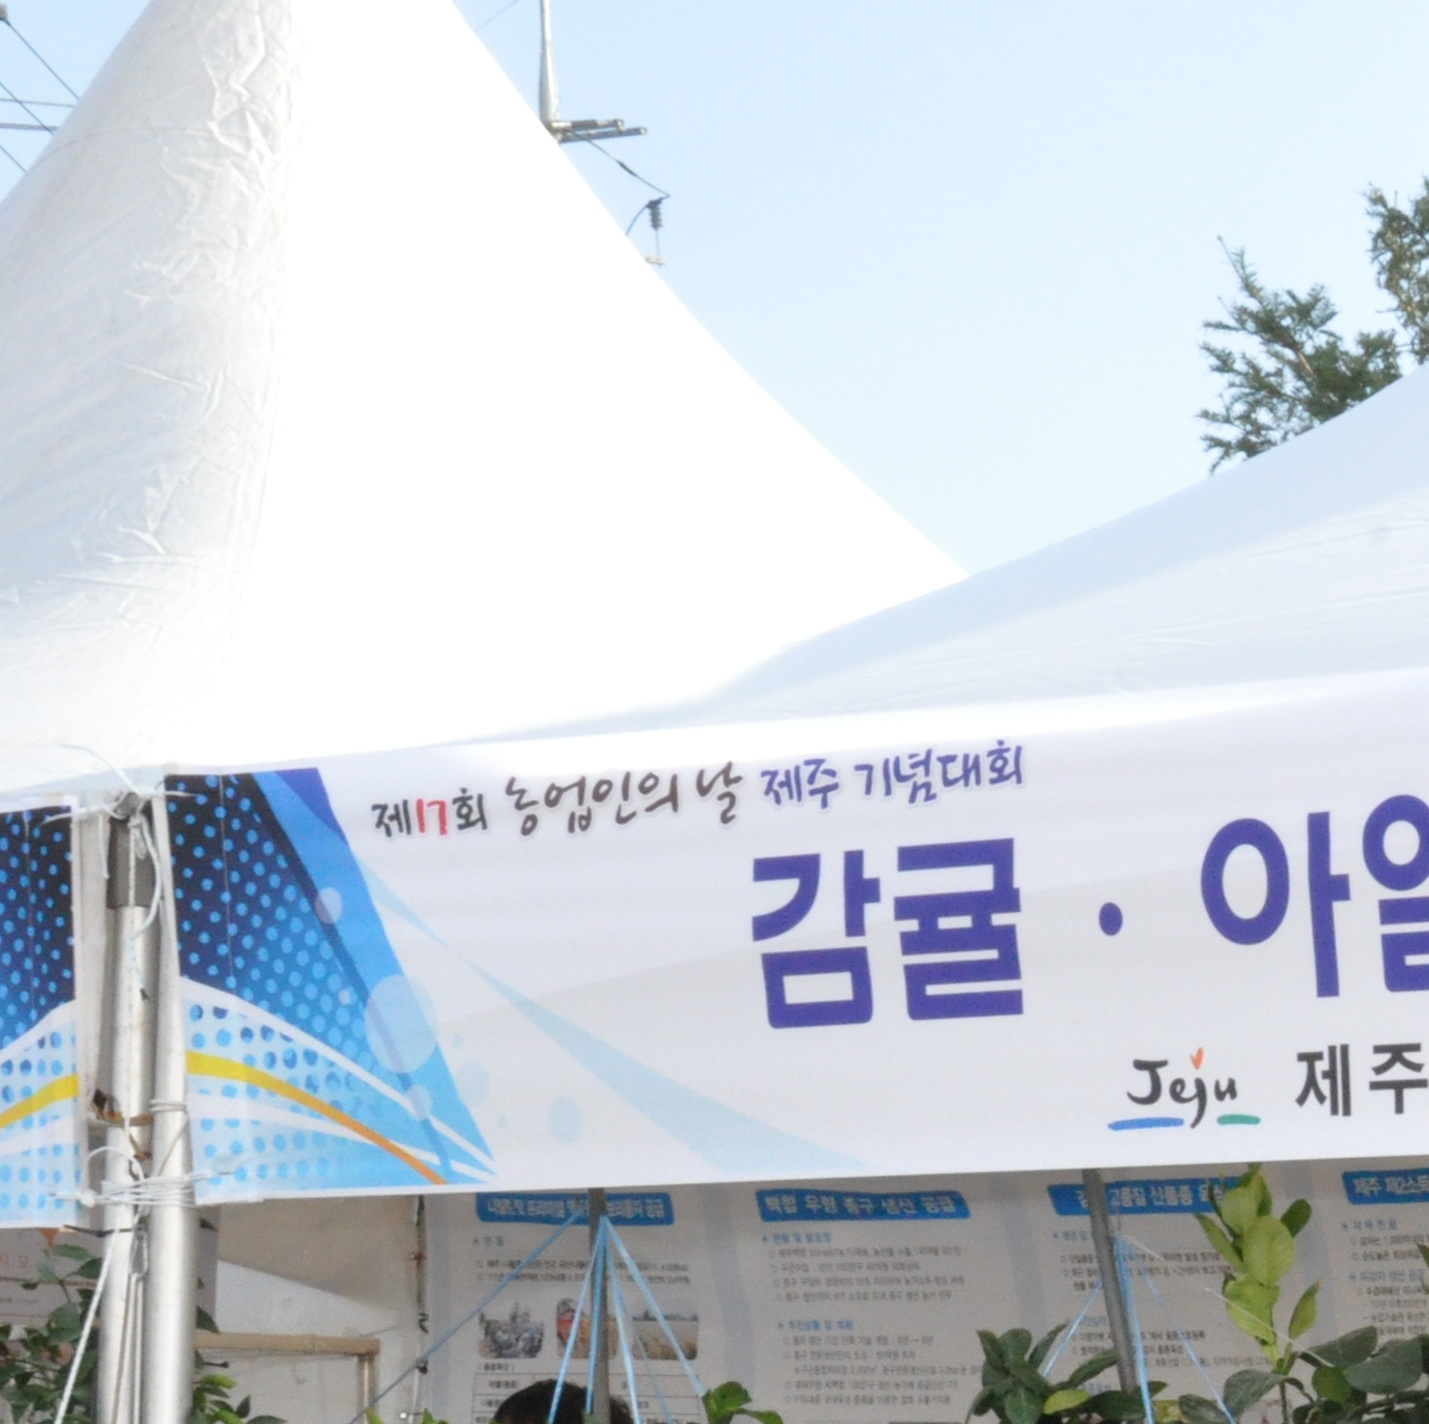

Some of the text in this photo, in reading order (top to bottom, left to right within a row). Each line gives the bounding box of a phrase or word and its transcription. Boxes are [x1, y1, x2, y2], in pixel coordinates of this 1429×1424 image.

[370, 740, 1027, 838] 제17회 농업인의 날 제주 기념대회
[750, 837, 1025, 1030] 감귤
[1126, 1047, 1239, 1130] Jeju
